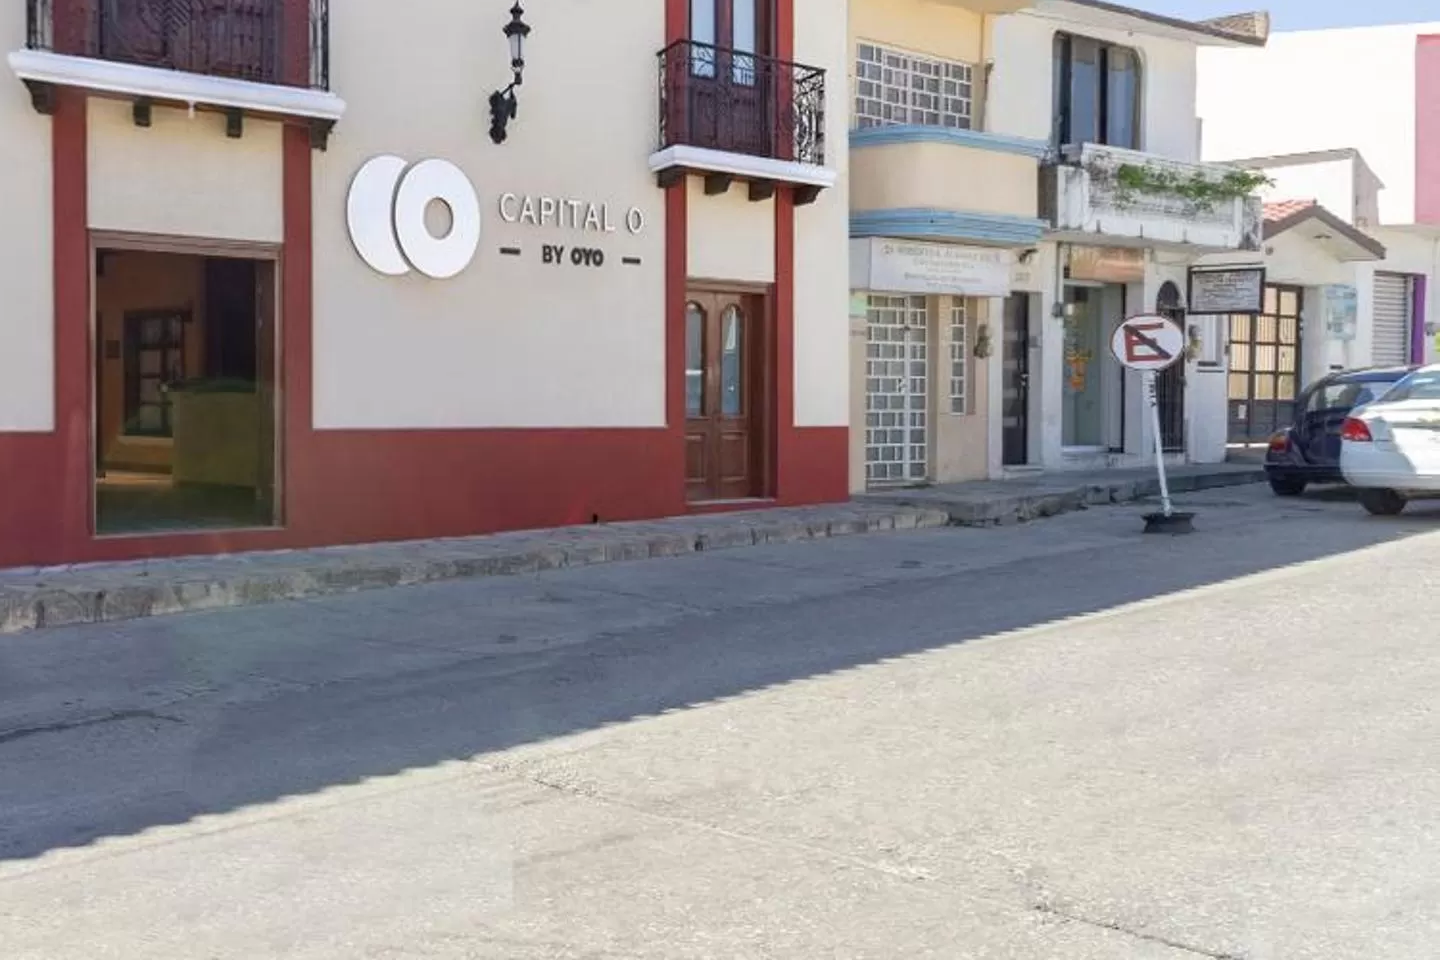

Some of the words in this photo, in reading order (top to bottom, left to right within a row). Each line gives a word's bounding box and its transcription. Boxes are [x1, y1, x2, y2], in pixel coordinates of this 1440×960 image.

[499, 193, 615, 232] CAPITAL
[626, 206, 644, 235] O
[542, 245, 564, 265] BY
[570, 247, 604, 267] OYO
